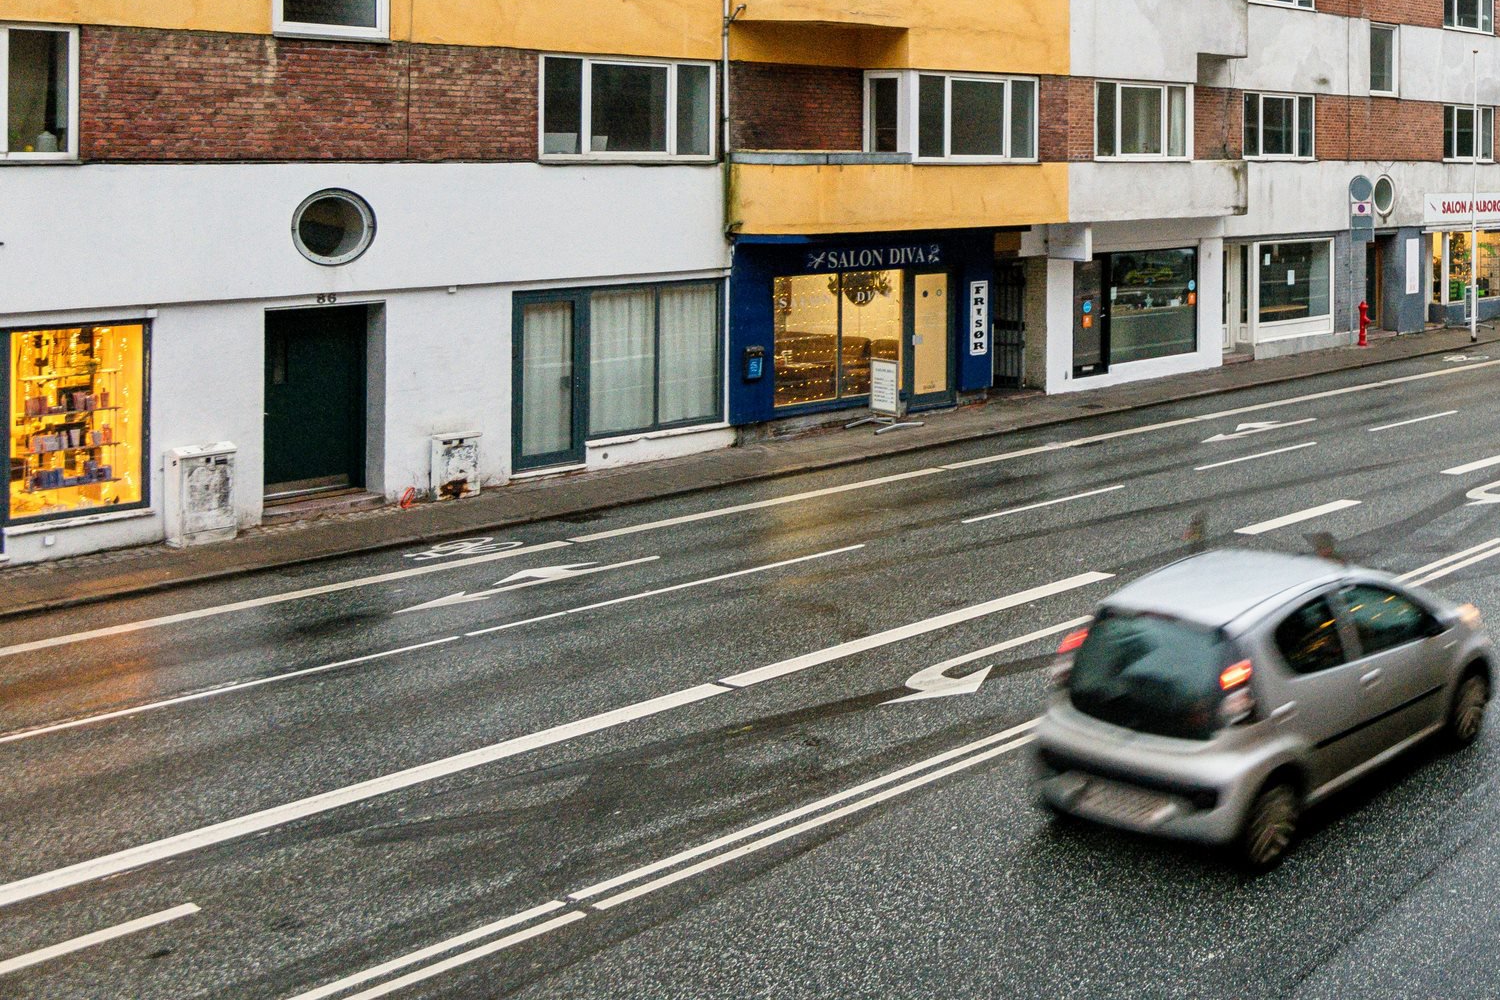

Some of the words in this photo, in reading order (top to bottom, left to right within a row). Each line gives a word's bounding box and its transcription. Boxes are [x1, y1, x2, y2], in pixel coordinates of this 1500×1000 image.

[1442, 200, 1467, 214] SALON
[827, 249, 884, 269] SALON
[889, 247, 926, 265] DIVA
[317, 293, 337, 304] 86
[973, 286, 985, 350] FRISØR
